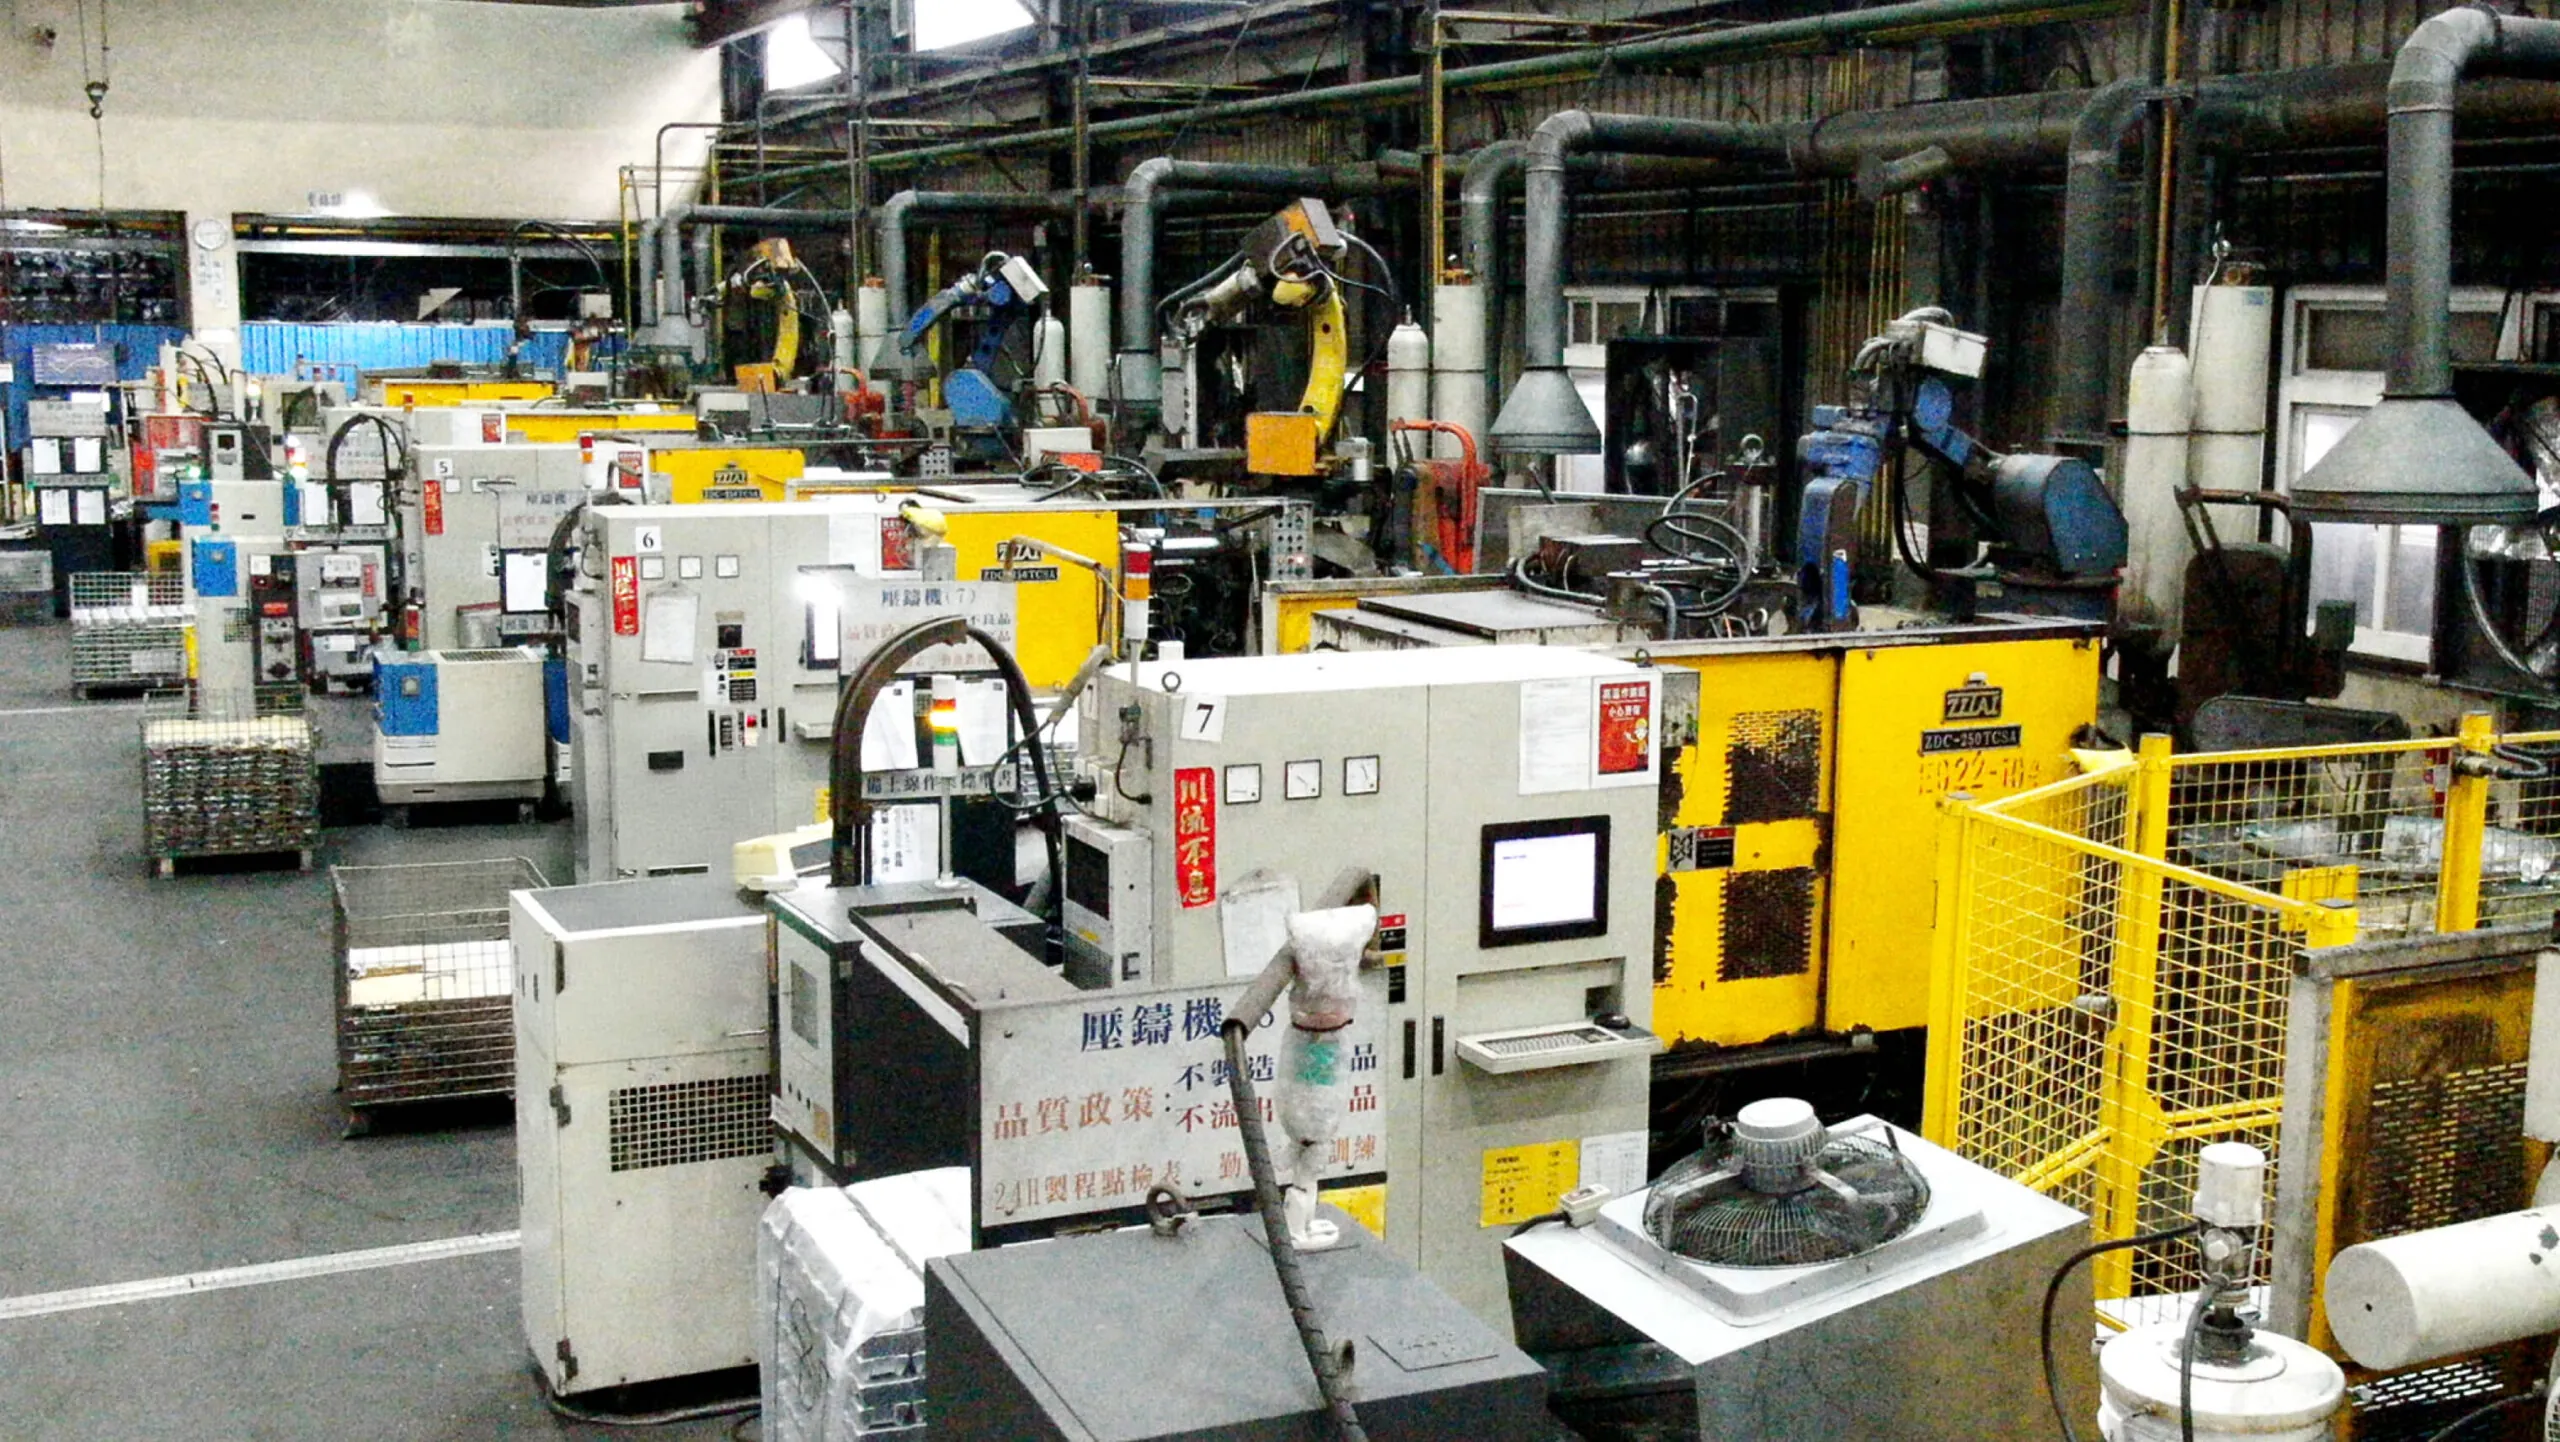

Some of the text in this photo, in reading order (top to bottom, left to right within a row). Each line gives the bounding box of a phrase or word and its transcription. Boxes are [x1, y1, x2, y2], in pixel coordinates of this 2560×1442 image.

[439, 461, 447, 473] 5
[642, 532, 654, 548] 6
[1196, 703, 1215, 734] 7
[1180, 773, 1210, 904] 川流不息
